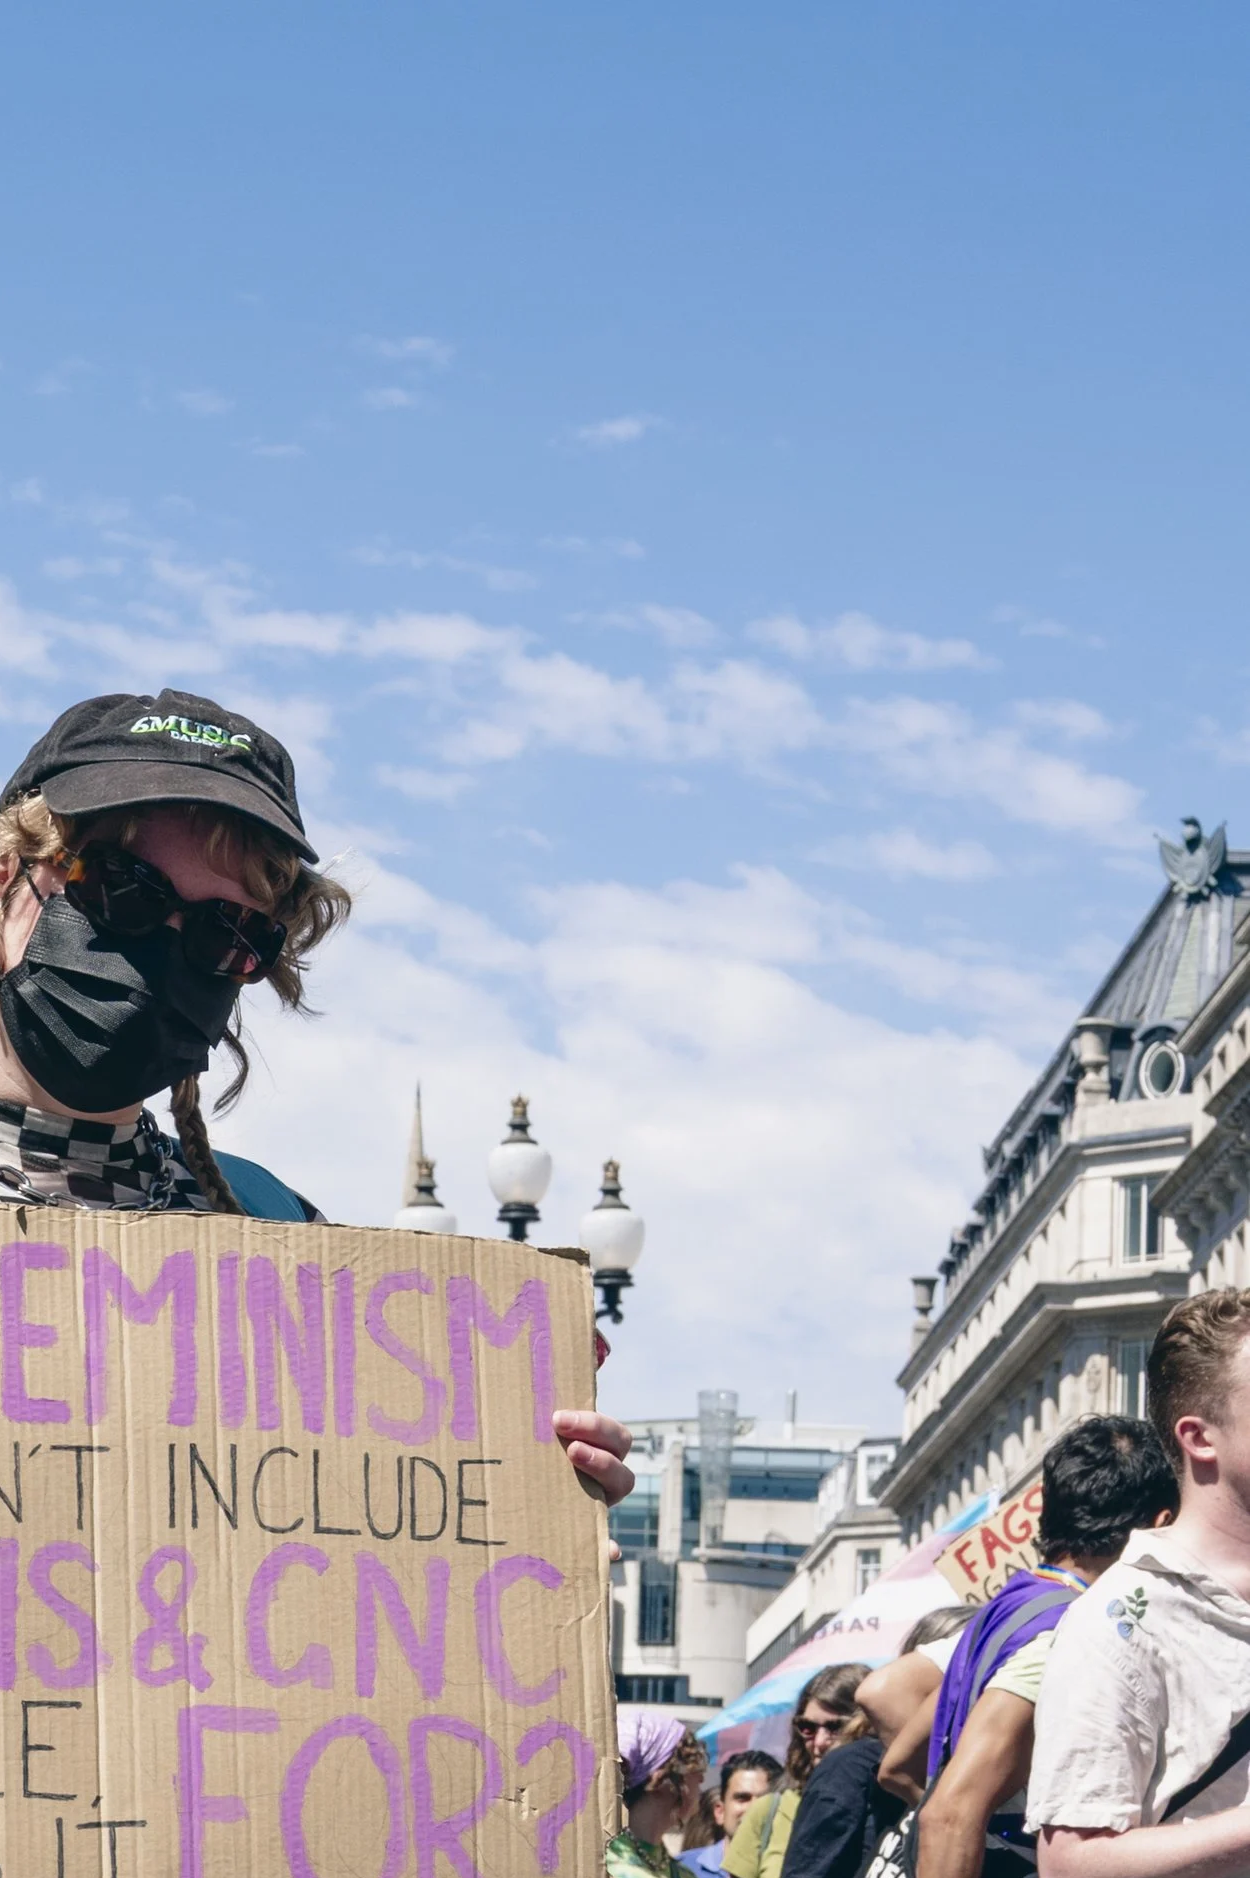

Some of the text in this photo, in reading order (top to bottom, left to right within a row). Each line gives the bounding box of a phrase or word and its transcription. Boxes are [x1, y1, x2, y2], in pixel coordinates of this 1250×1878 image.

[130, 715, 251, 751] 6MUSIC
[168, 1443, 508, 1546] INCLUDE
[132, 1545, 213, 1692] &
[245, 1542, 566, 1707] GNC
